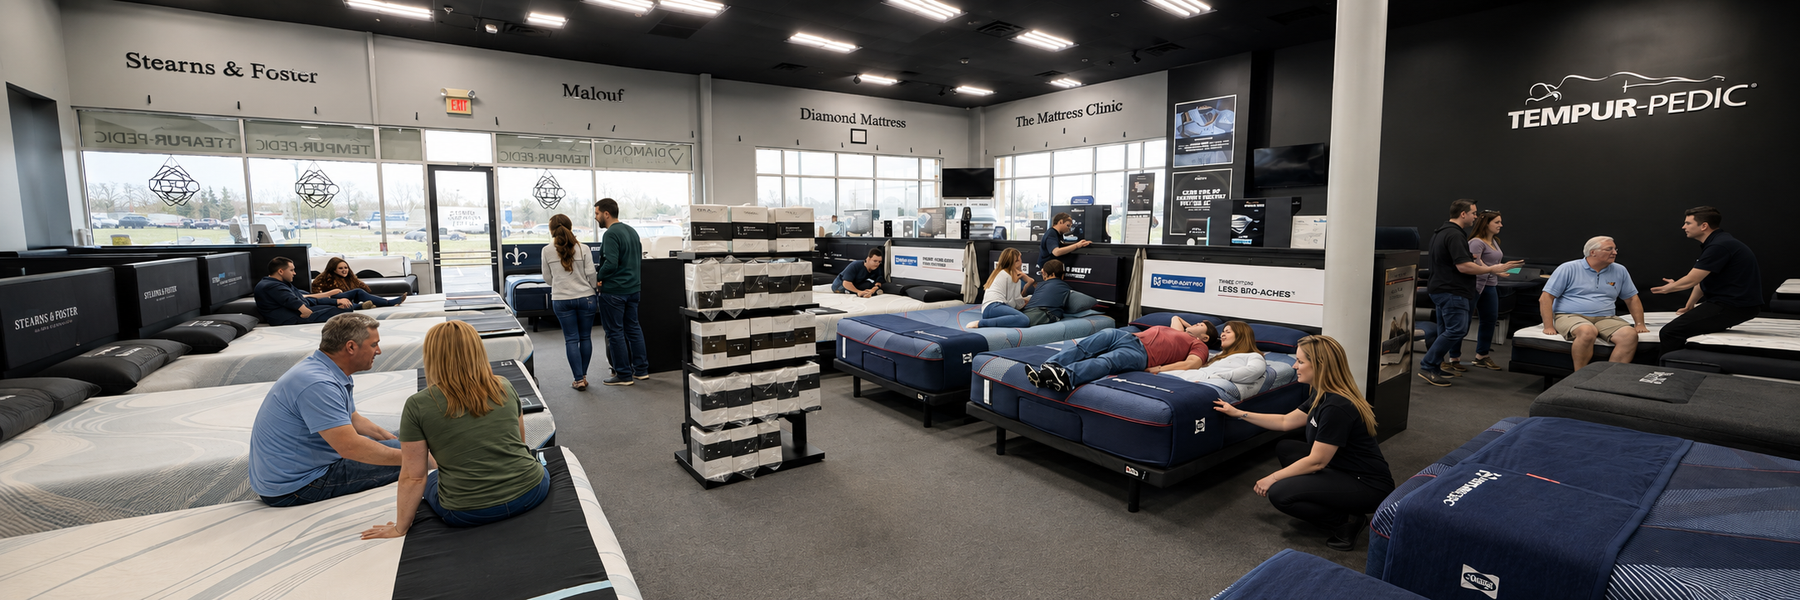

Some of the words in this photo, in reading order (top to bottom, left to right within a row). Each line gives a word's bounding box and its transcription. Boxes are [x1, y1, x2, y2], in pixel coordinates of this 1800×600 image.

[125, 52, 216, 75] Stearns
[223, 61, 244, 77] &
[250, 62, 318, 83] Foster
[562, 83, 625, 101] Malouf
[451, 99, 468, 111] EXIT
[1015, 115, 1035, 128] The
[1037, 108, 1083, 124] Mattress
[1086, 99, 1123, 116] Clinic
[800, 107, 856, 124] Diamond
[860, 113, 906, 128] Mattress
[1218, 285, 1238, 293] LESS
[14, 313, 49, 330] STEARNS
[55, 306, 78, 320] FOSTER
